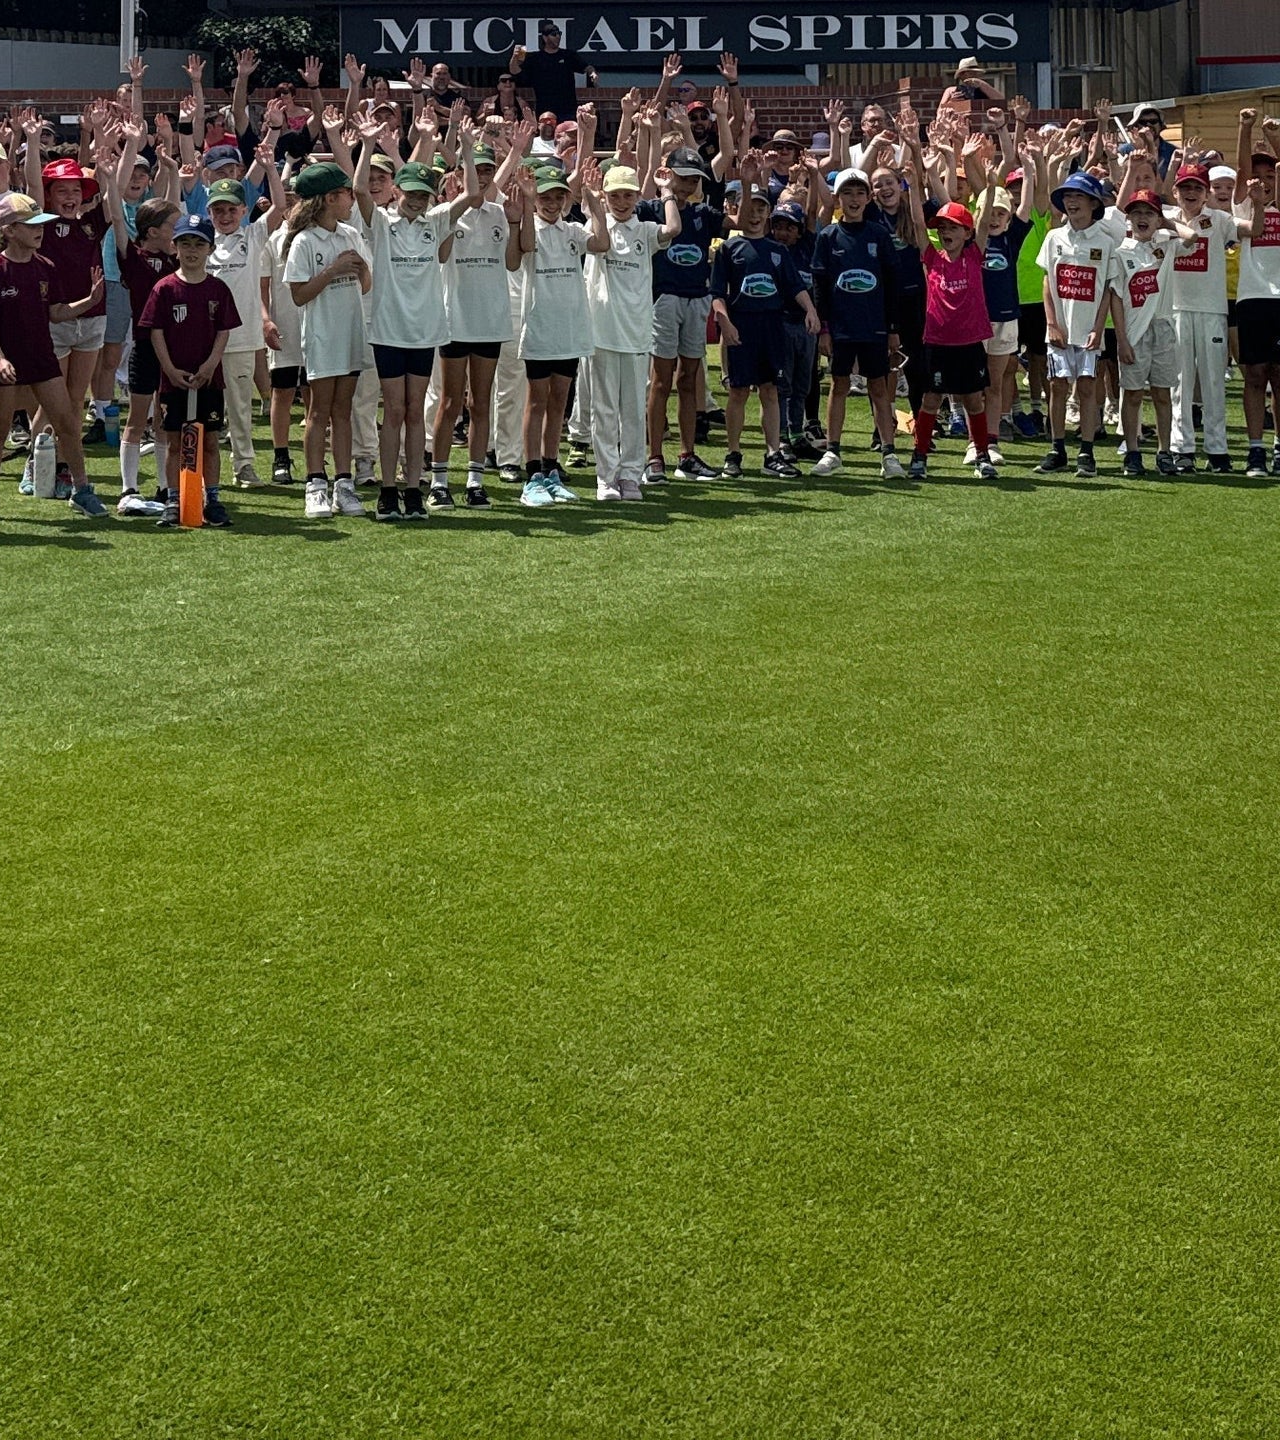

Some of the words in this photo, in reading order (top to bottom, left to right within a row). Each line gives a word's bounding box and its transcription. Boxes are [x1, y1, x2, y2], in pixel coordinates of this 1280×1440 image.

[373, 15, 724, 55] MICHAEL
[748, 13, 1020, 52] SPIERS
[1174, 258, 1205, 266] ANNER
[1059, 268, 1094, 281] COOPER
[1130, 276, 1156, 287] COOP
[1058, 284, 1093, 296] TANNER
